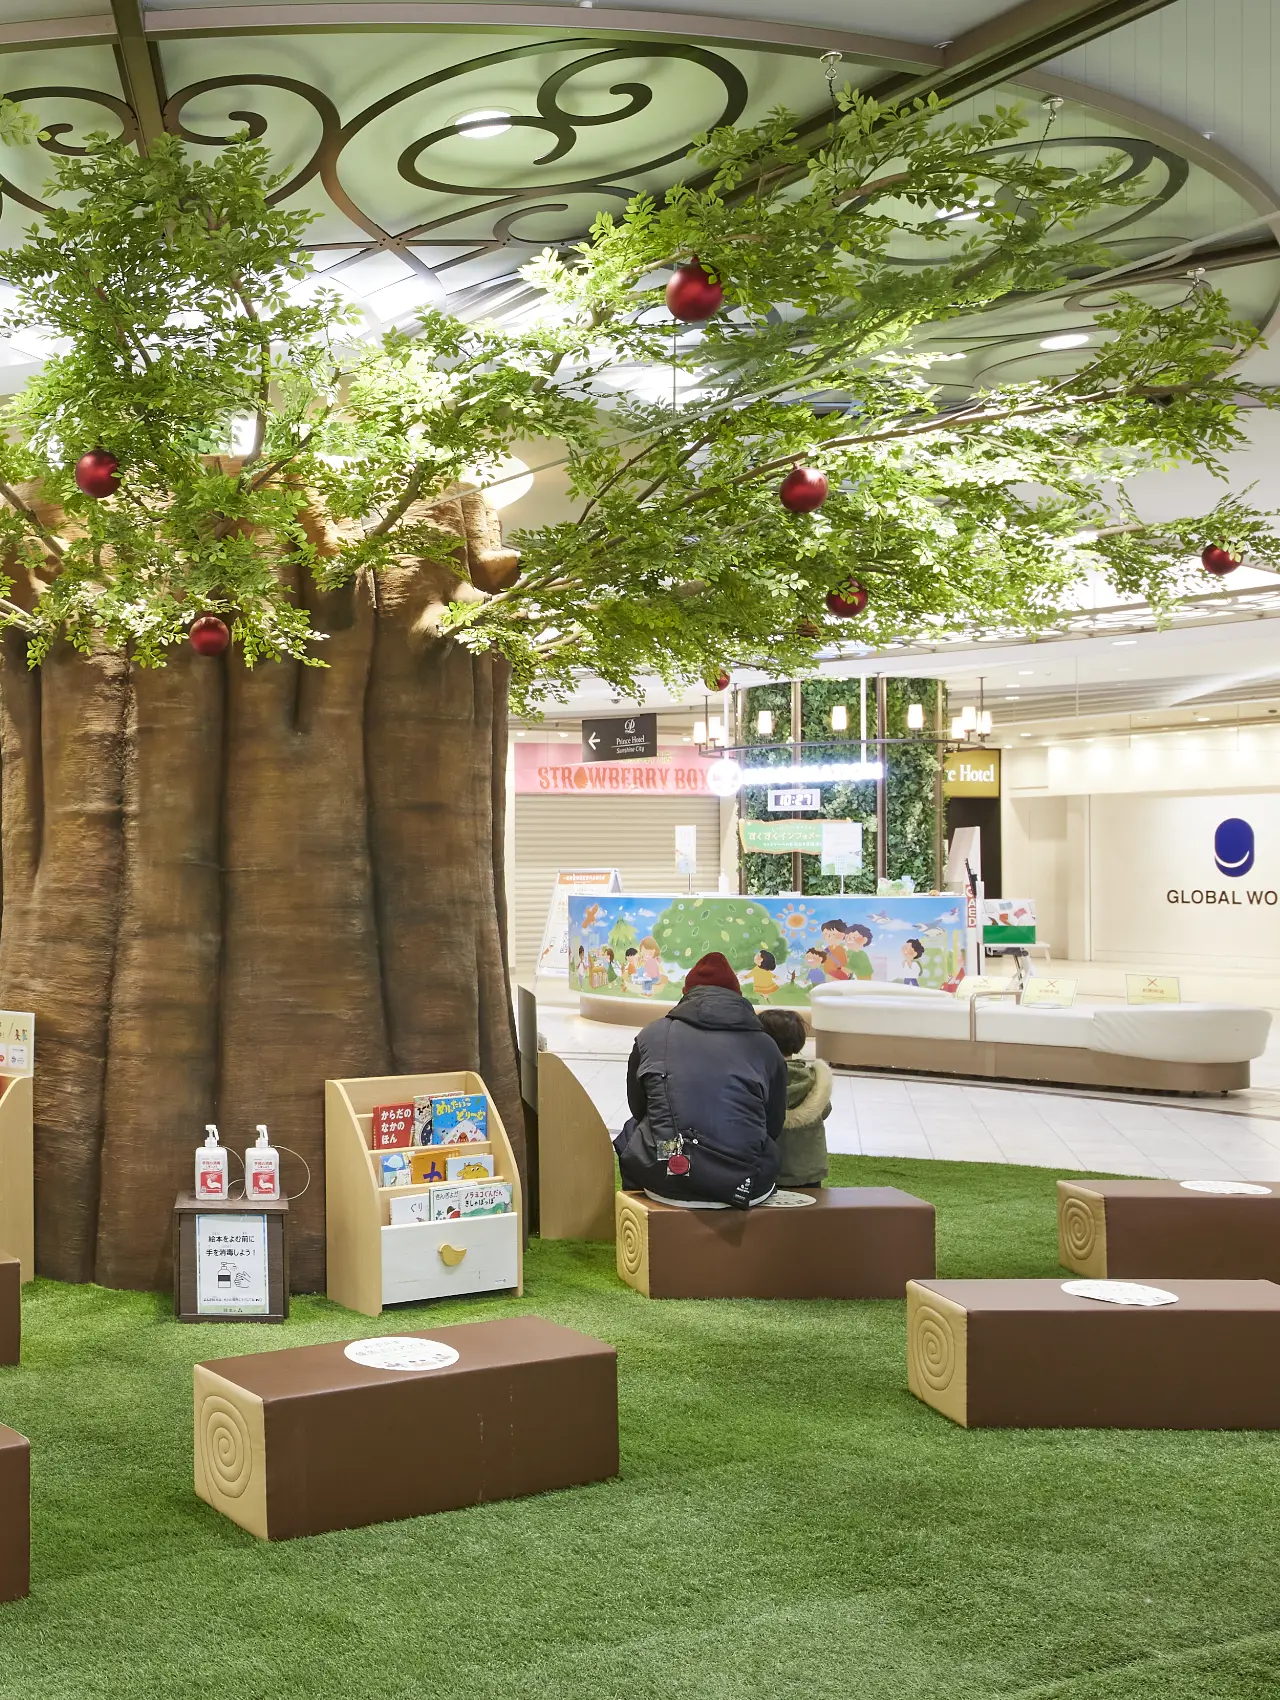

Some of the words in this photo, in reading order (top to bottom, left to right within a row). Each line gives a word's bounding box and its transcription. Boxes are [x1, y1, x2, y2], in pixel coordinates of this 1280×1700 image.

[616, 737, 631, 746] Prince
[631, 735, 645, 744] Hotel
[616, 747, 635, 755] Sunshine
[636, 745, 645, 753] City
[959, 763, 995, 782] Hotel
[778, 793, 812, 807] 10:27
[1166, 889, 1242, 905] GLOBAL
[1246, 890, 1278, 906] WO
[381, 1108, 412, 1120] からだの
[381, 1121, 405, 1133] なかの
[381, 1133, 398, 1145] ほん
[208, 1235, 255, 1243] 絵本をよむ前に
